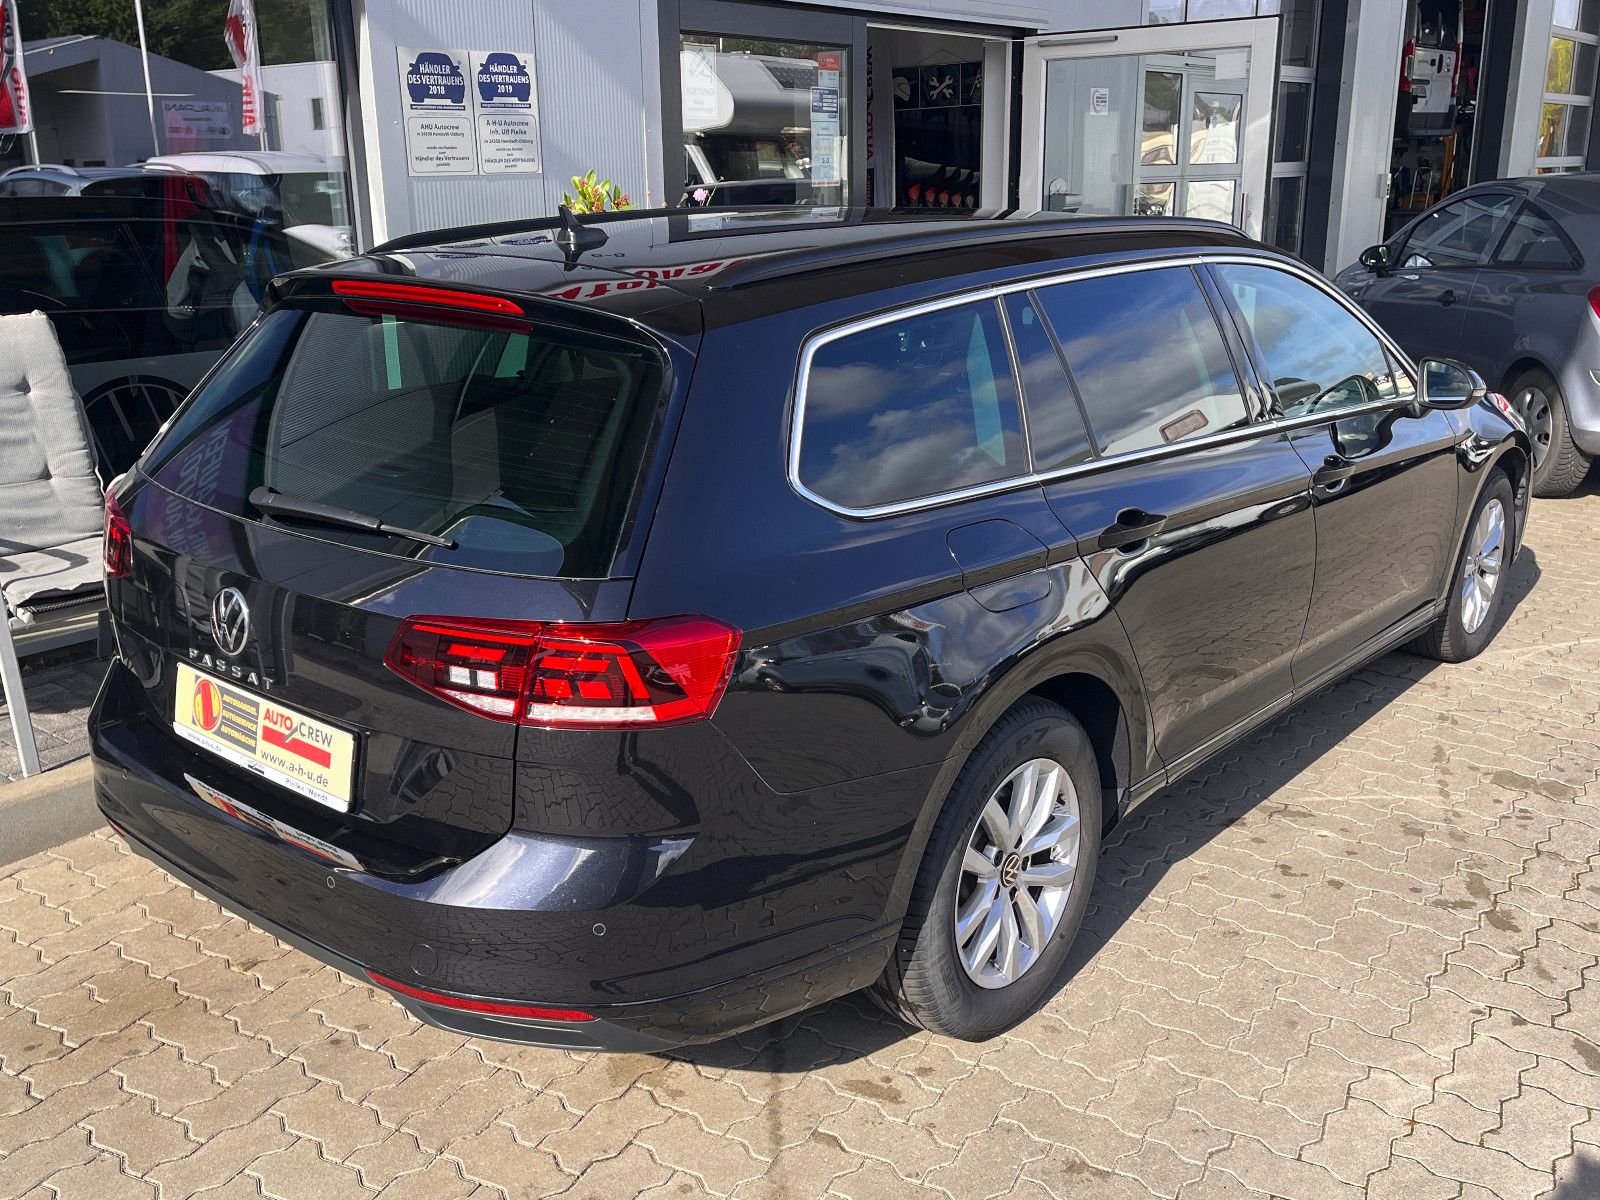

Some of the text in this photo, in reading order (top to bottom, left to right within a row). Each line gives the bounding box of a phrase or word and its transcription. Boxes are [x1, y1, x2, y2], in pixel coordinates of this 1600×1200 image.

[420, 62, 450, 74] HÄNDLER
[489, 63, 518, 74] HÄNDLER
[408, 74, 464, 86] DES VERTRAUENS
[479, 74, 530, 84] DES VERTRAUENS
[429, 86, 445, 94] 2018
[497, 84, 513, 93] 2019
[189, 648, 273, 689] PASSAT
[264, 708, 333, 747] AUTO CREW
[261, 750, 329, 787] www.a-h-u.de
